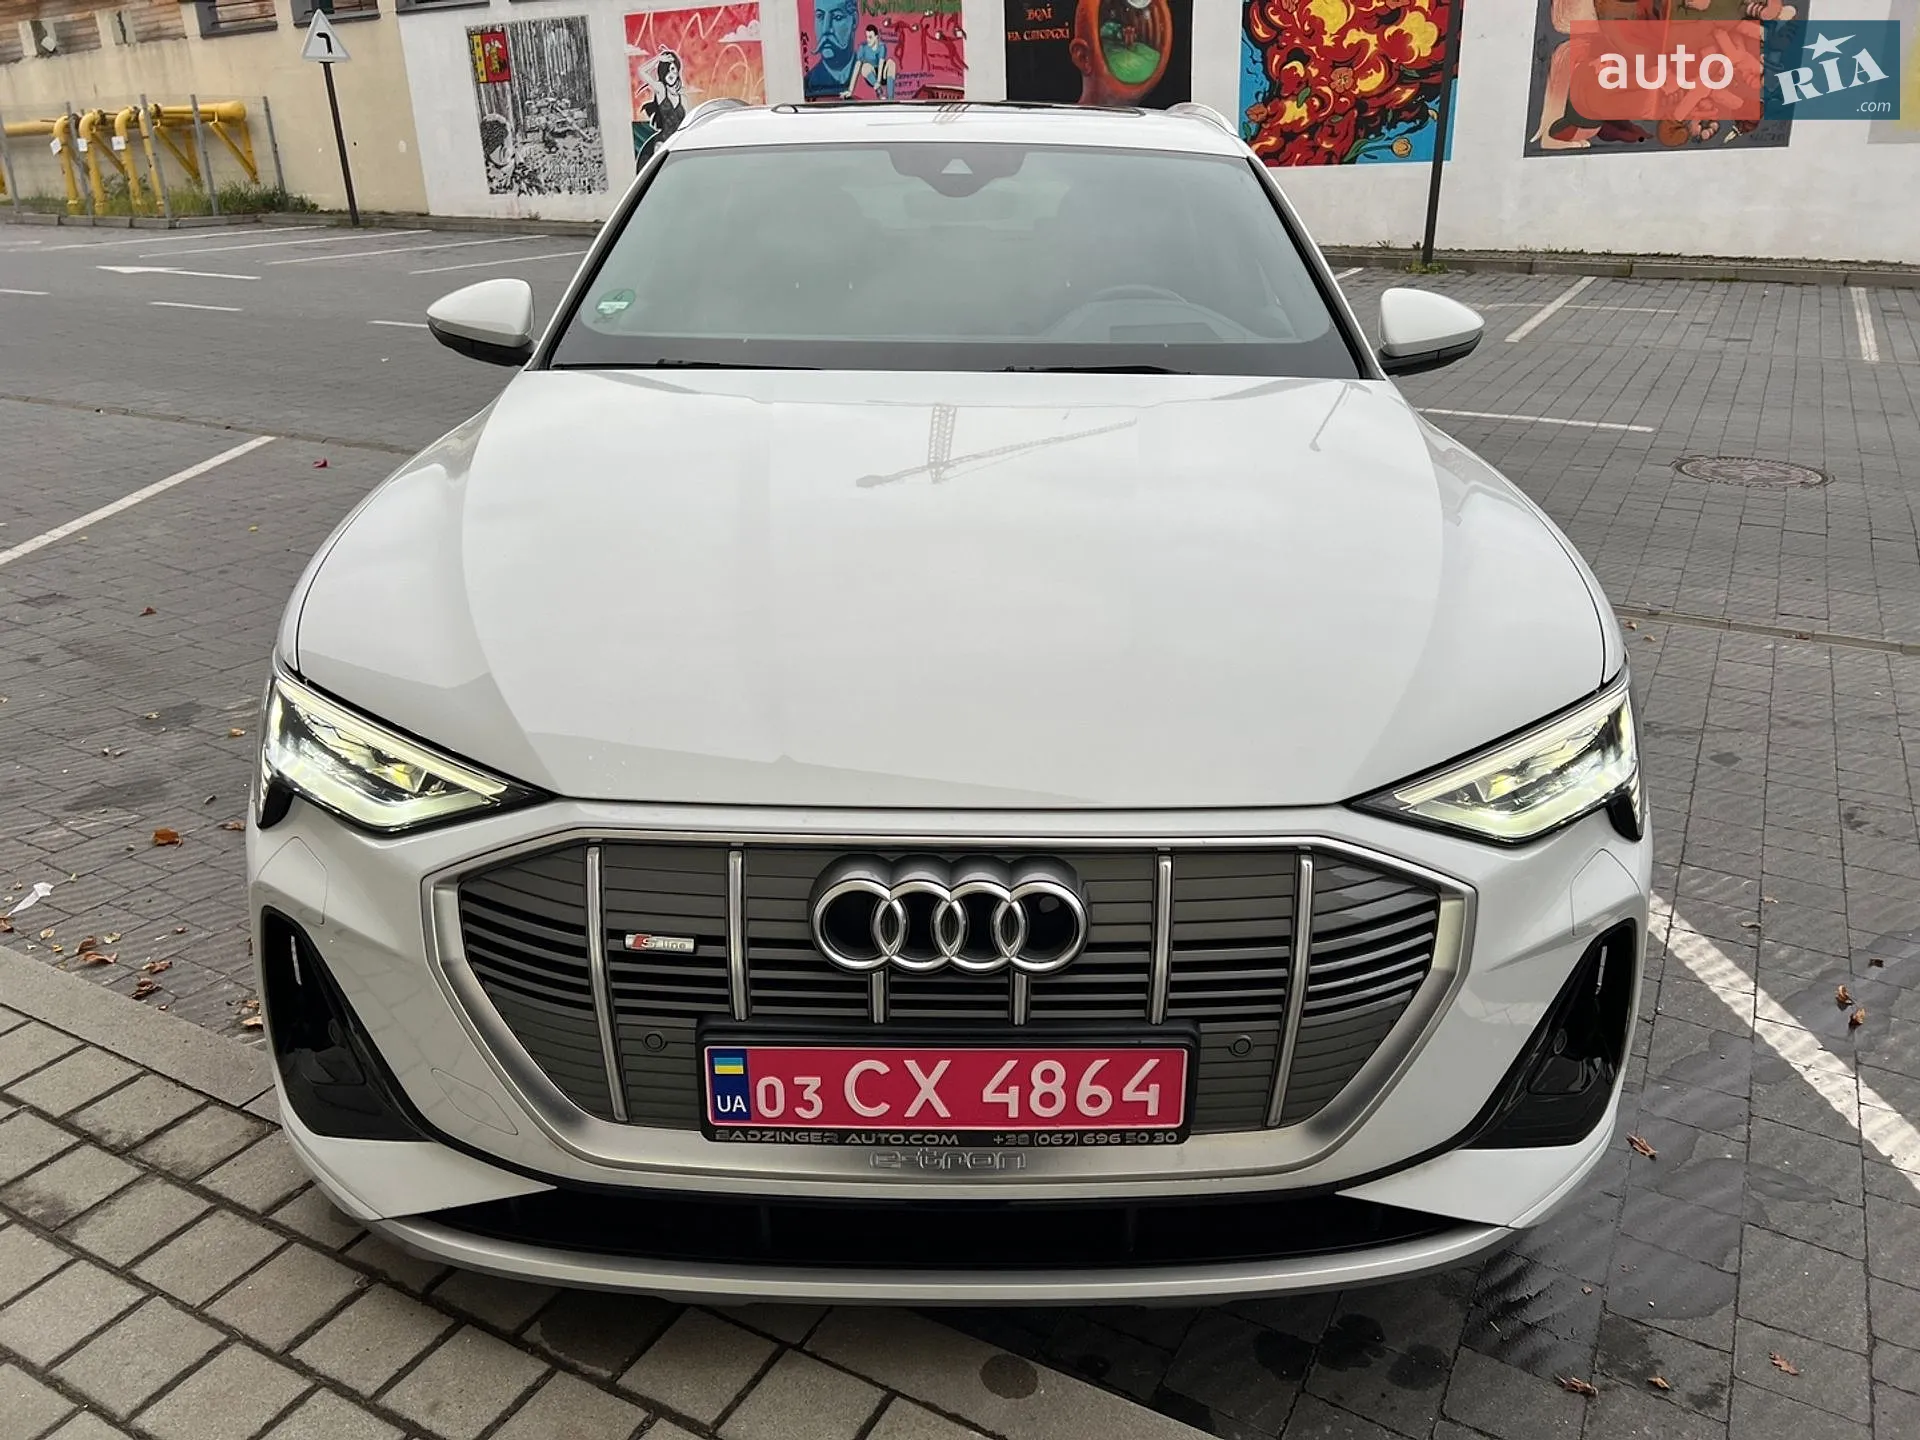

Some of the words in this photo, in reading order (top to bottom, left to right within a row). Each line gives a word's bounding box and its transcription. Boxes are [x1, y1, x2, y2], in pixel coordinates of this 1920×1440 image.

[756, 1076, 823, 1119] 03
[844, 1059, 951, 1118] CX
[983, 1058, 1160, 1118] 4864
[717, 1095, 747, 1112] UA
[845, 1132, 959, 1146] AUTO.COM
[1033, 1132, 1079, 1146] (067)
[1083, 1132, 1121, 1144] 696
[1152, 1131, 1177, 1143] 30
[869, 1148, 1027, 1170] e-tron
